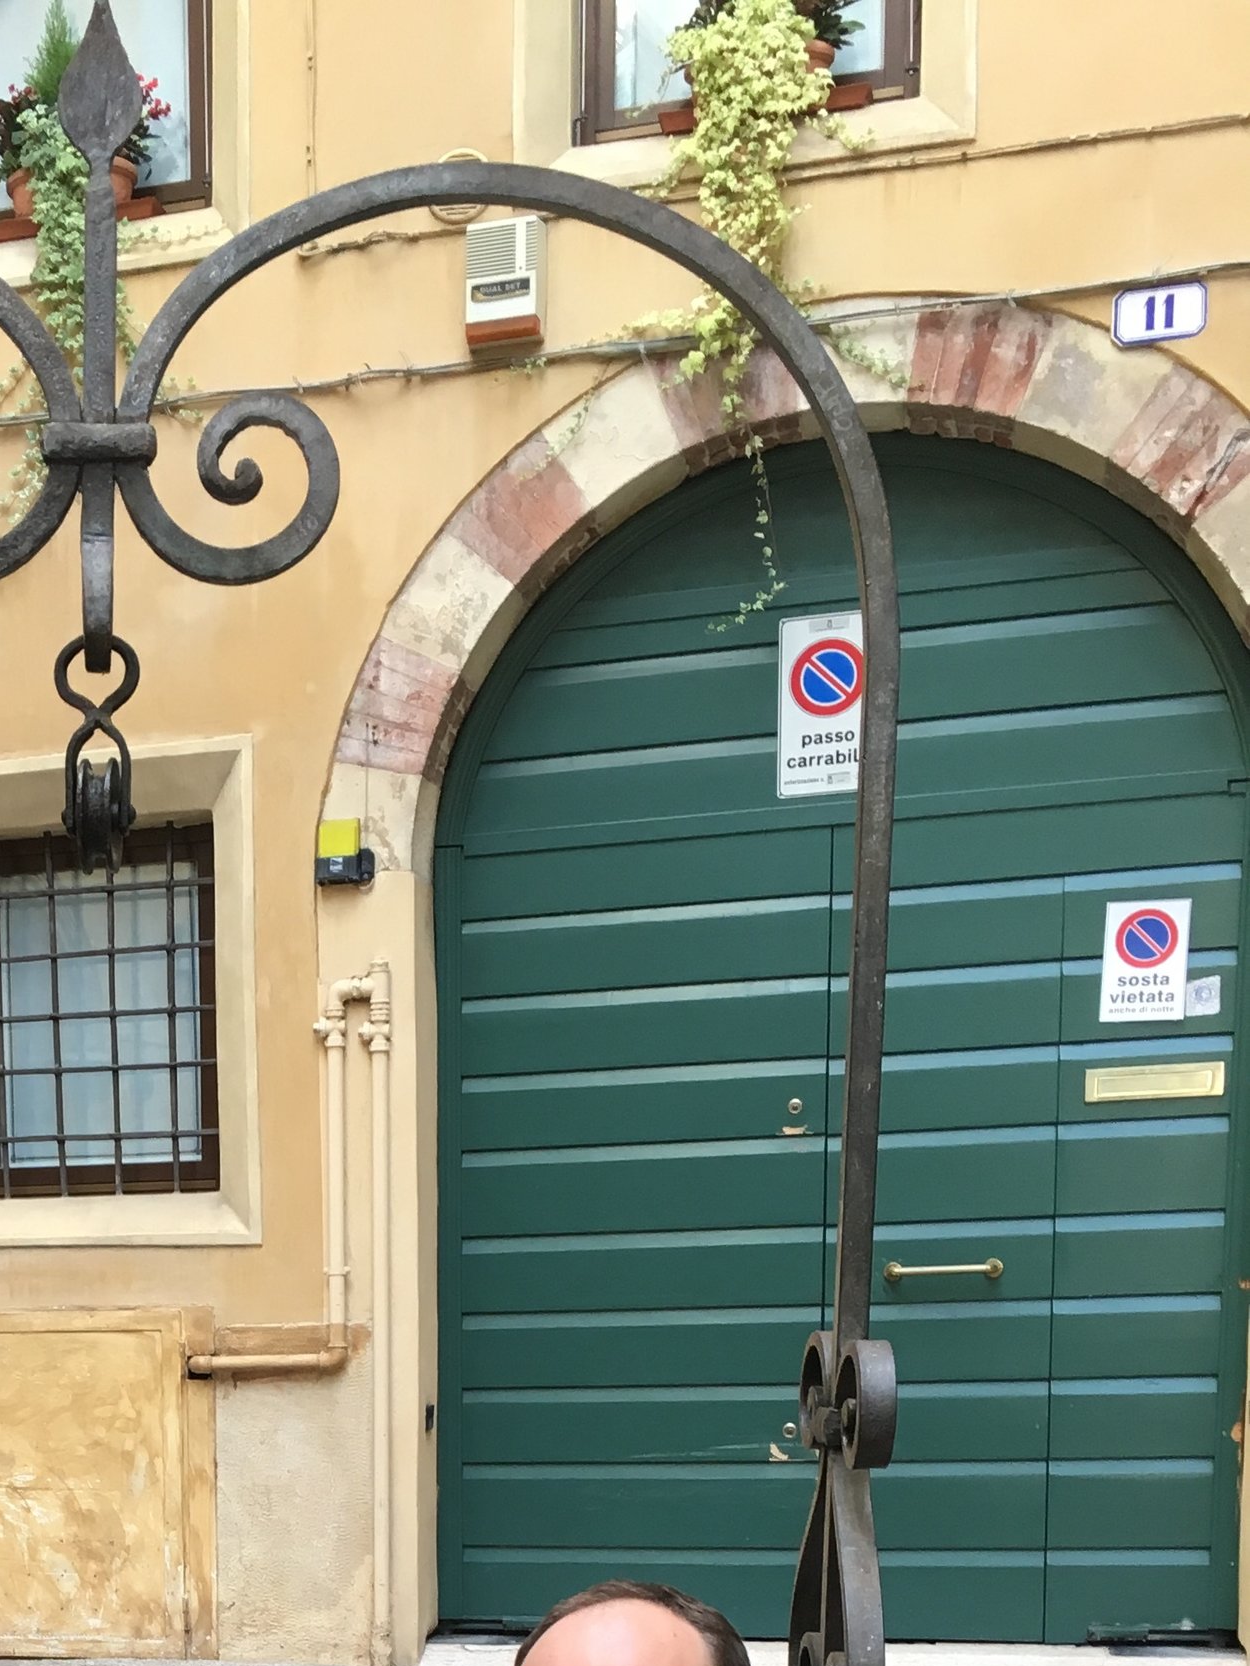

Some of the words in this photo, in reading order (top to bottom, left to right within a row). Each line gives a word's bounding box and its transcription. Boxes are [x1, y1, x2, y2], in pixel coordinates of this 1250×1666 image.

[1143, 293, 1175, 331] 11
[801, 730, 855, 748] passo
[786, 747, 859, 769] carrabil
[1117, 973, 1170, 987] sosta
[1110, 990, 1175, 1004] vietata
[1108, 1006, 1136, 1014] anche
